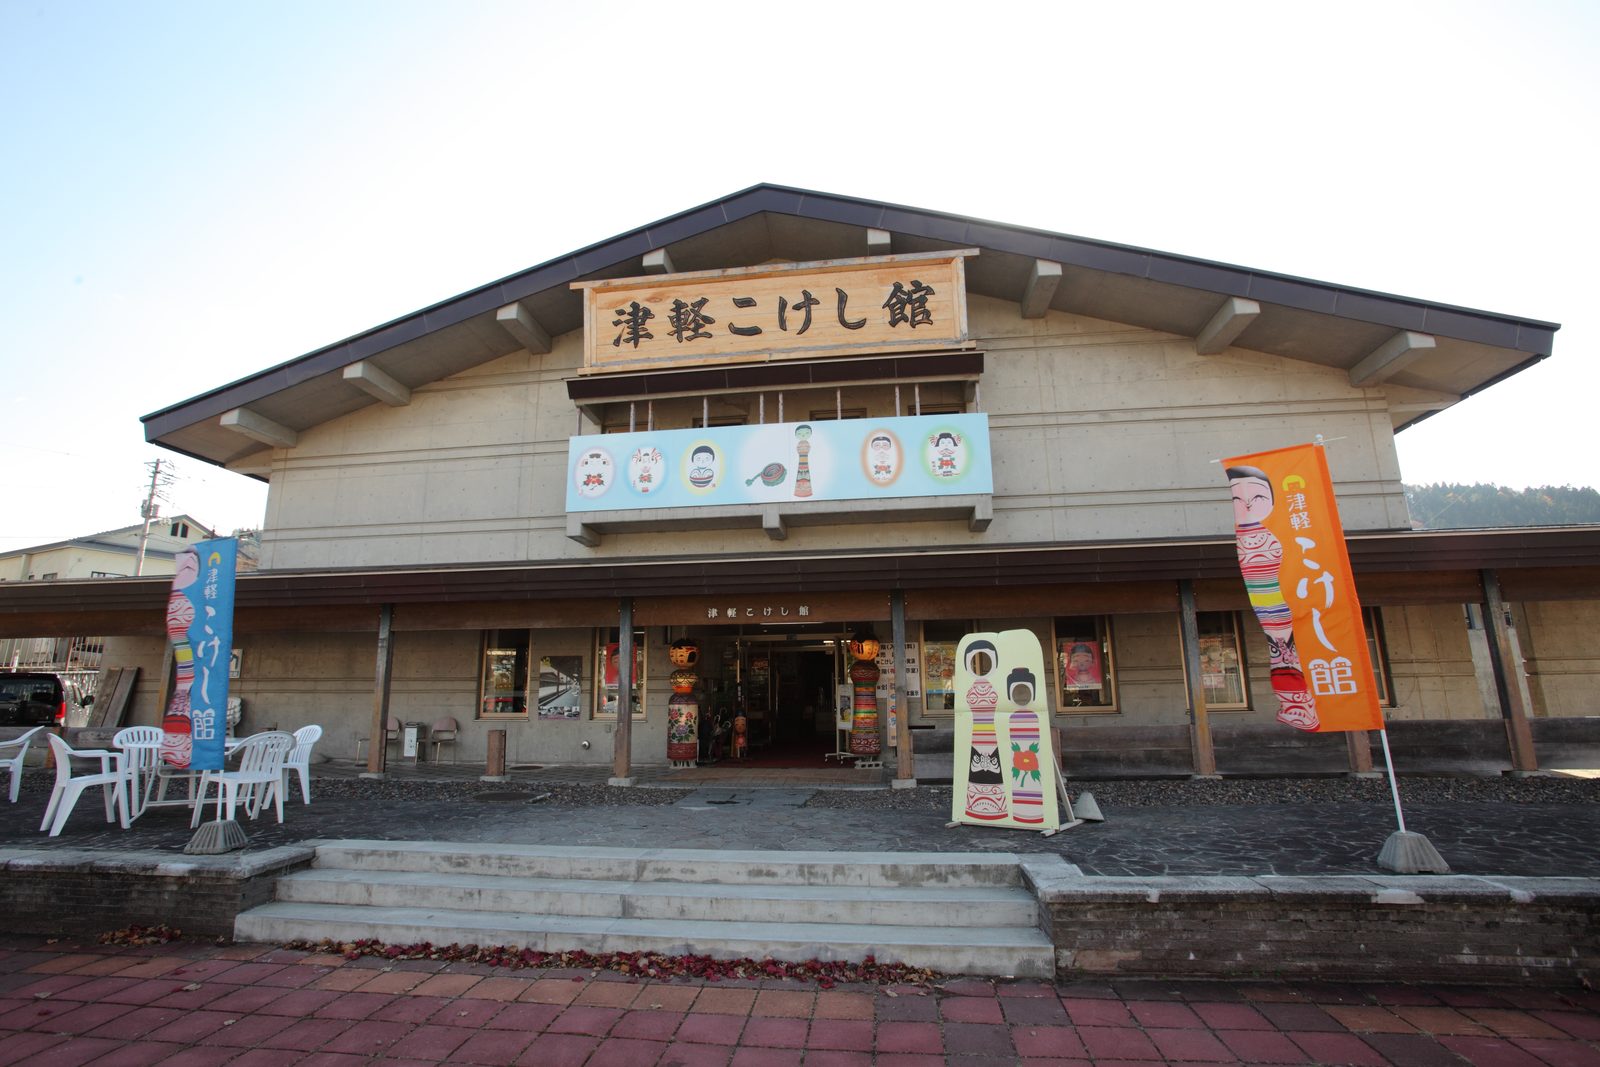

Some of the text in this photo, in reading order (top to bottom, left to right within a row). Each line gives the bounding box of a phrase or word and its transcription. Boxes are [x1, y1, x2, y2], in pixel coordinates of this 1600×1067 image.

[611, 279, 936, 349] 津軽こけし館
[707, 605, 810, 618] 津軽こけし館
